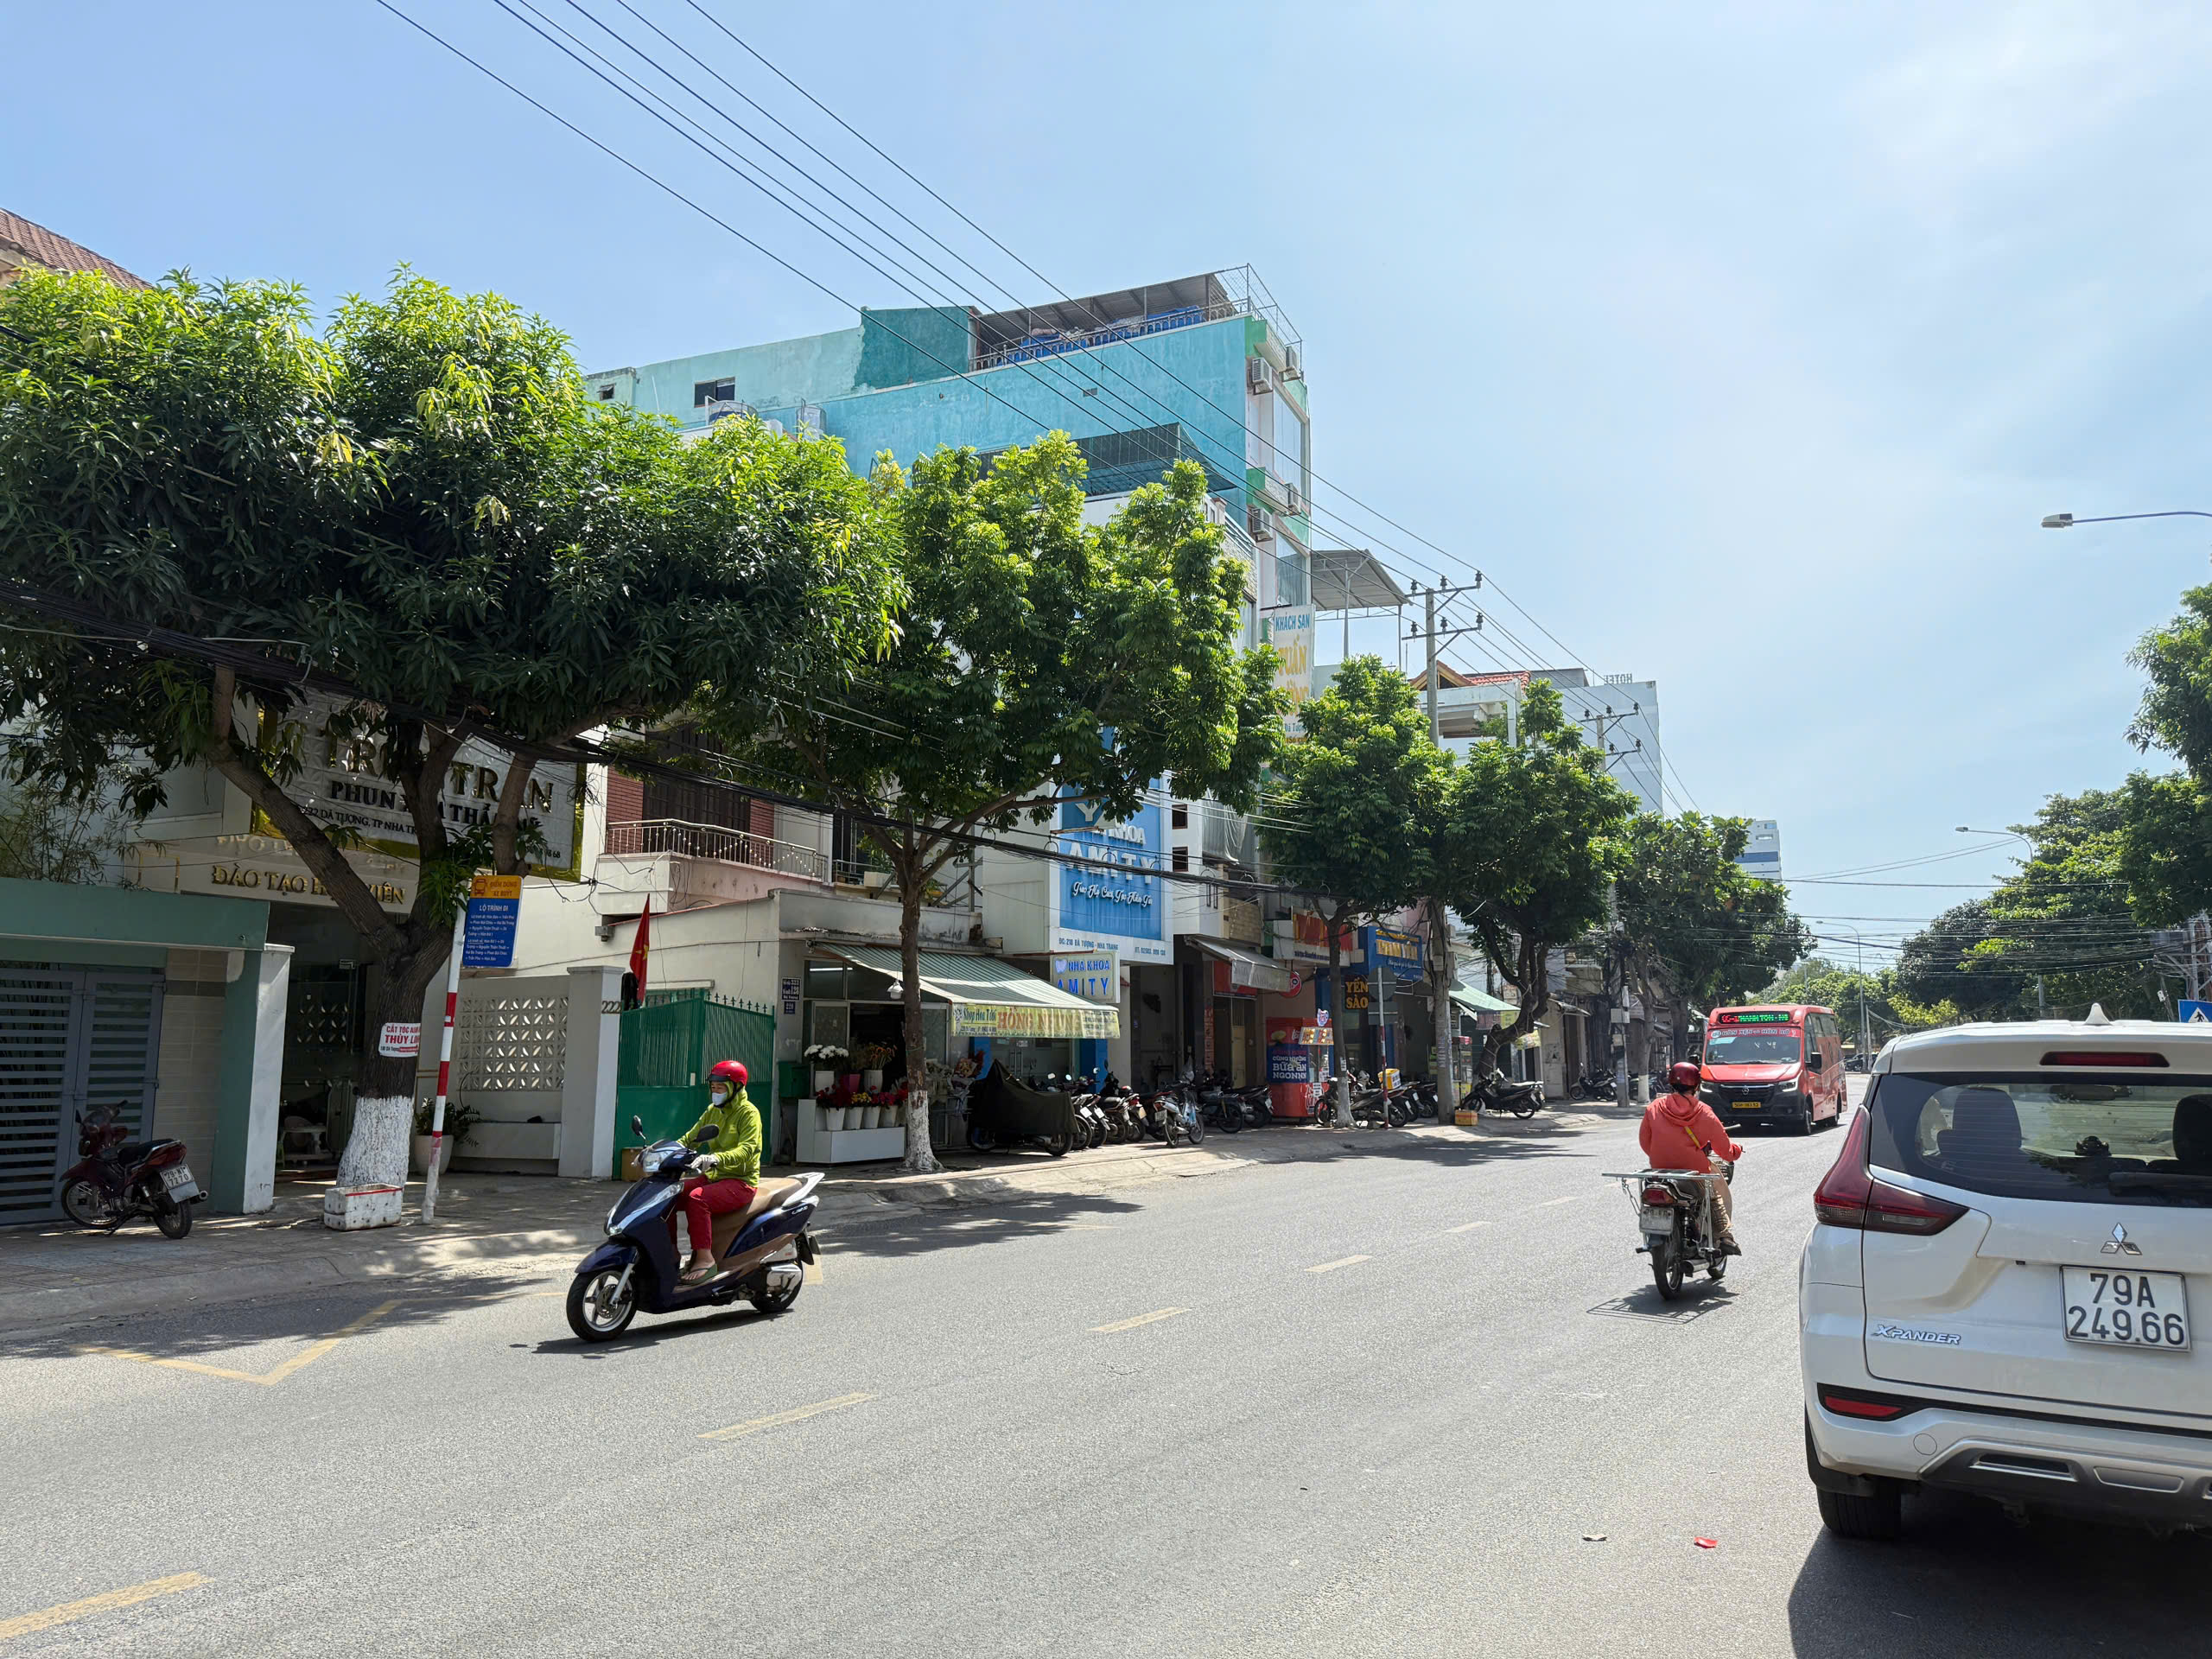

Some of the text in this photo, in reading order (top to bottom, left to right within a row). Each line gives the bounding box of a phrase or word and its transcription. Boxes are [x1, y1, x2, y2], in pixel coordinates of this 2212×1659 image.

[1275, 612, 1310, 632] KHÁCH SẠN
[331, 781, 397, 810] PHUN
[448, 760, 554, 813] TRN
[385, 821, 405, 833] NHA
[1067, 842, 1156, 884] AMITY
[212, 863, 260, 888] ĐÀO
[264, 871, 307, 896] TẠO
[1068, 960, 1110, 971] NHA KHOA
[1058, 977, 1109, 996] AMITY
[1345, 977, 1369, 993] YẾN
[601, 1000, 621, 1014] 222
[1345, 995, 1369, 1009] SÀO
[997, 1006, 1033, 1030] HỒNG
[2089, 1272, 2156, 1308] 79A
[1872, 1324, 1961, 1345] XPANDER
[2068, 1306, 2185, 1345] 249.66
